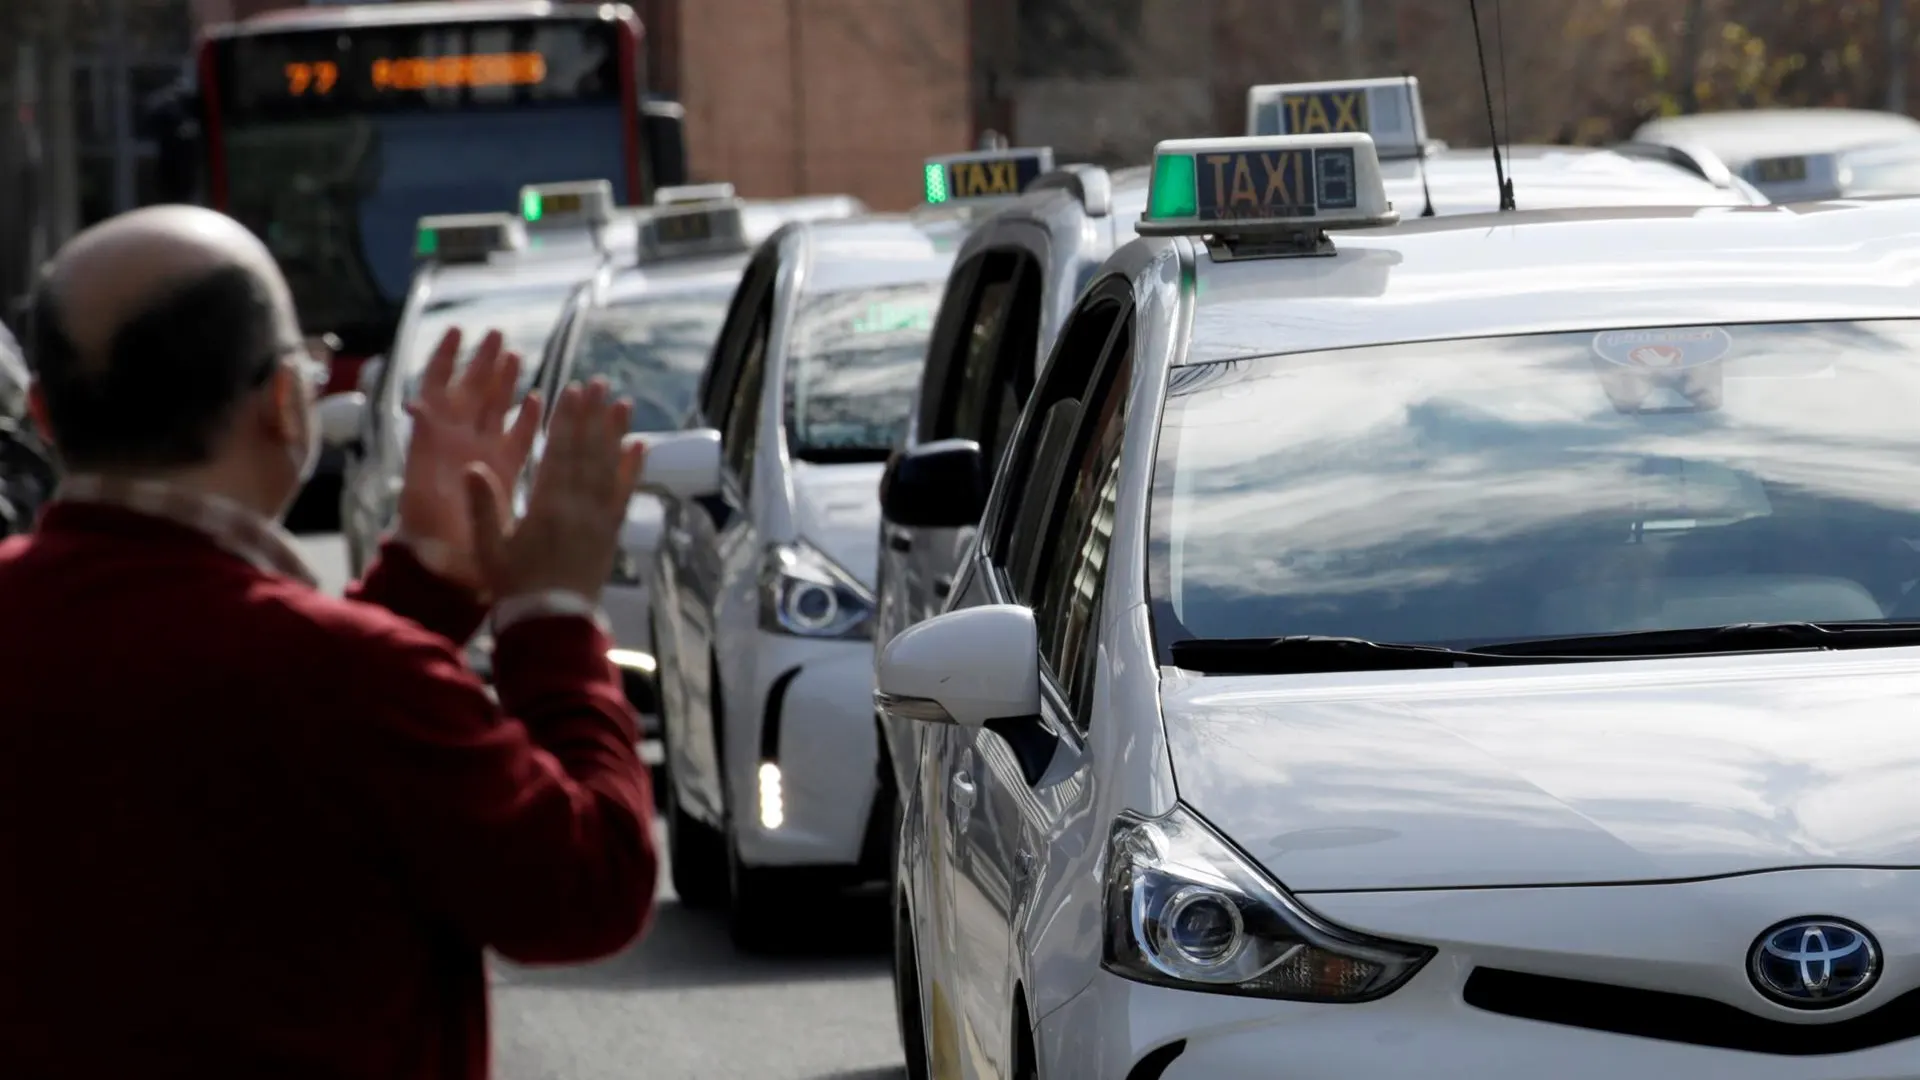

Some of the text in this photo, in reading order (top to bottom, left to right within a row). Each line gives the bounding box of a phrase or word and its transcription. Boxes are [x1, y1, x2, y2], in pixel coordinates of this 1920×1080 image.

[1283, 91, 1369, 134] TAXI
[951, 162, 1017, 198] TAXI
[1206, 152, 1305, 209] TAXI
